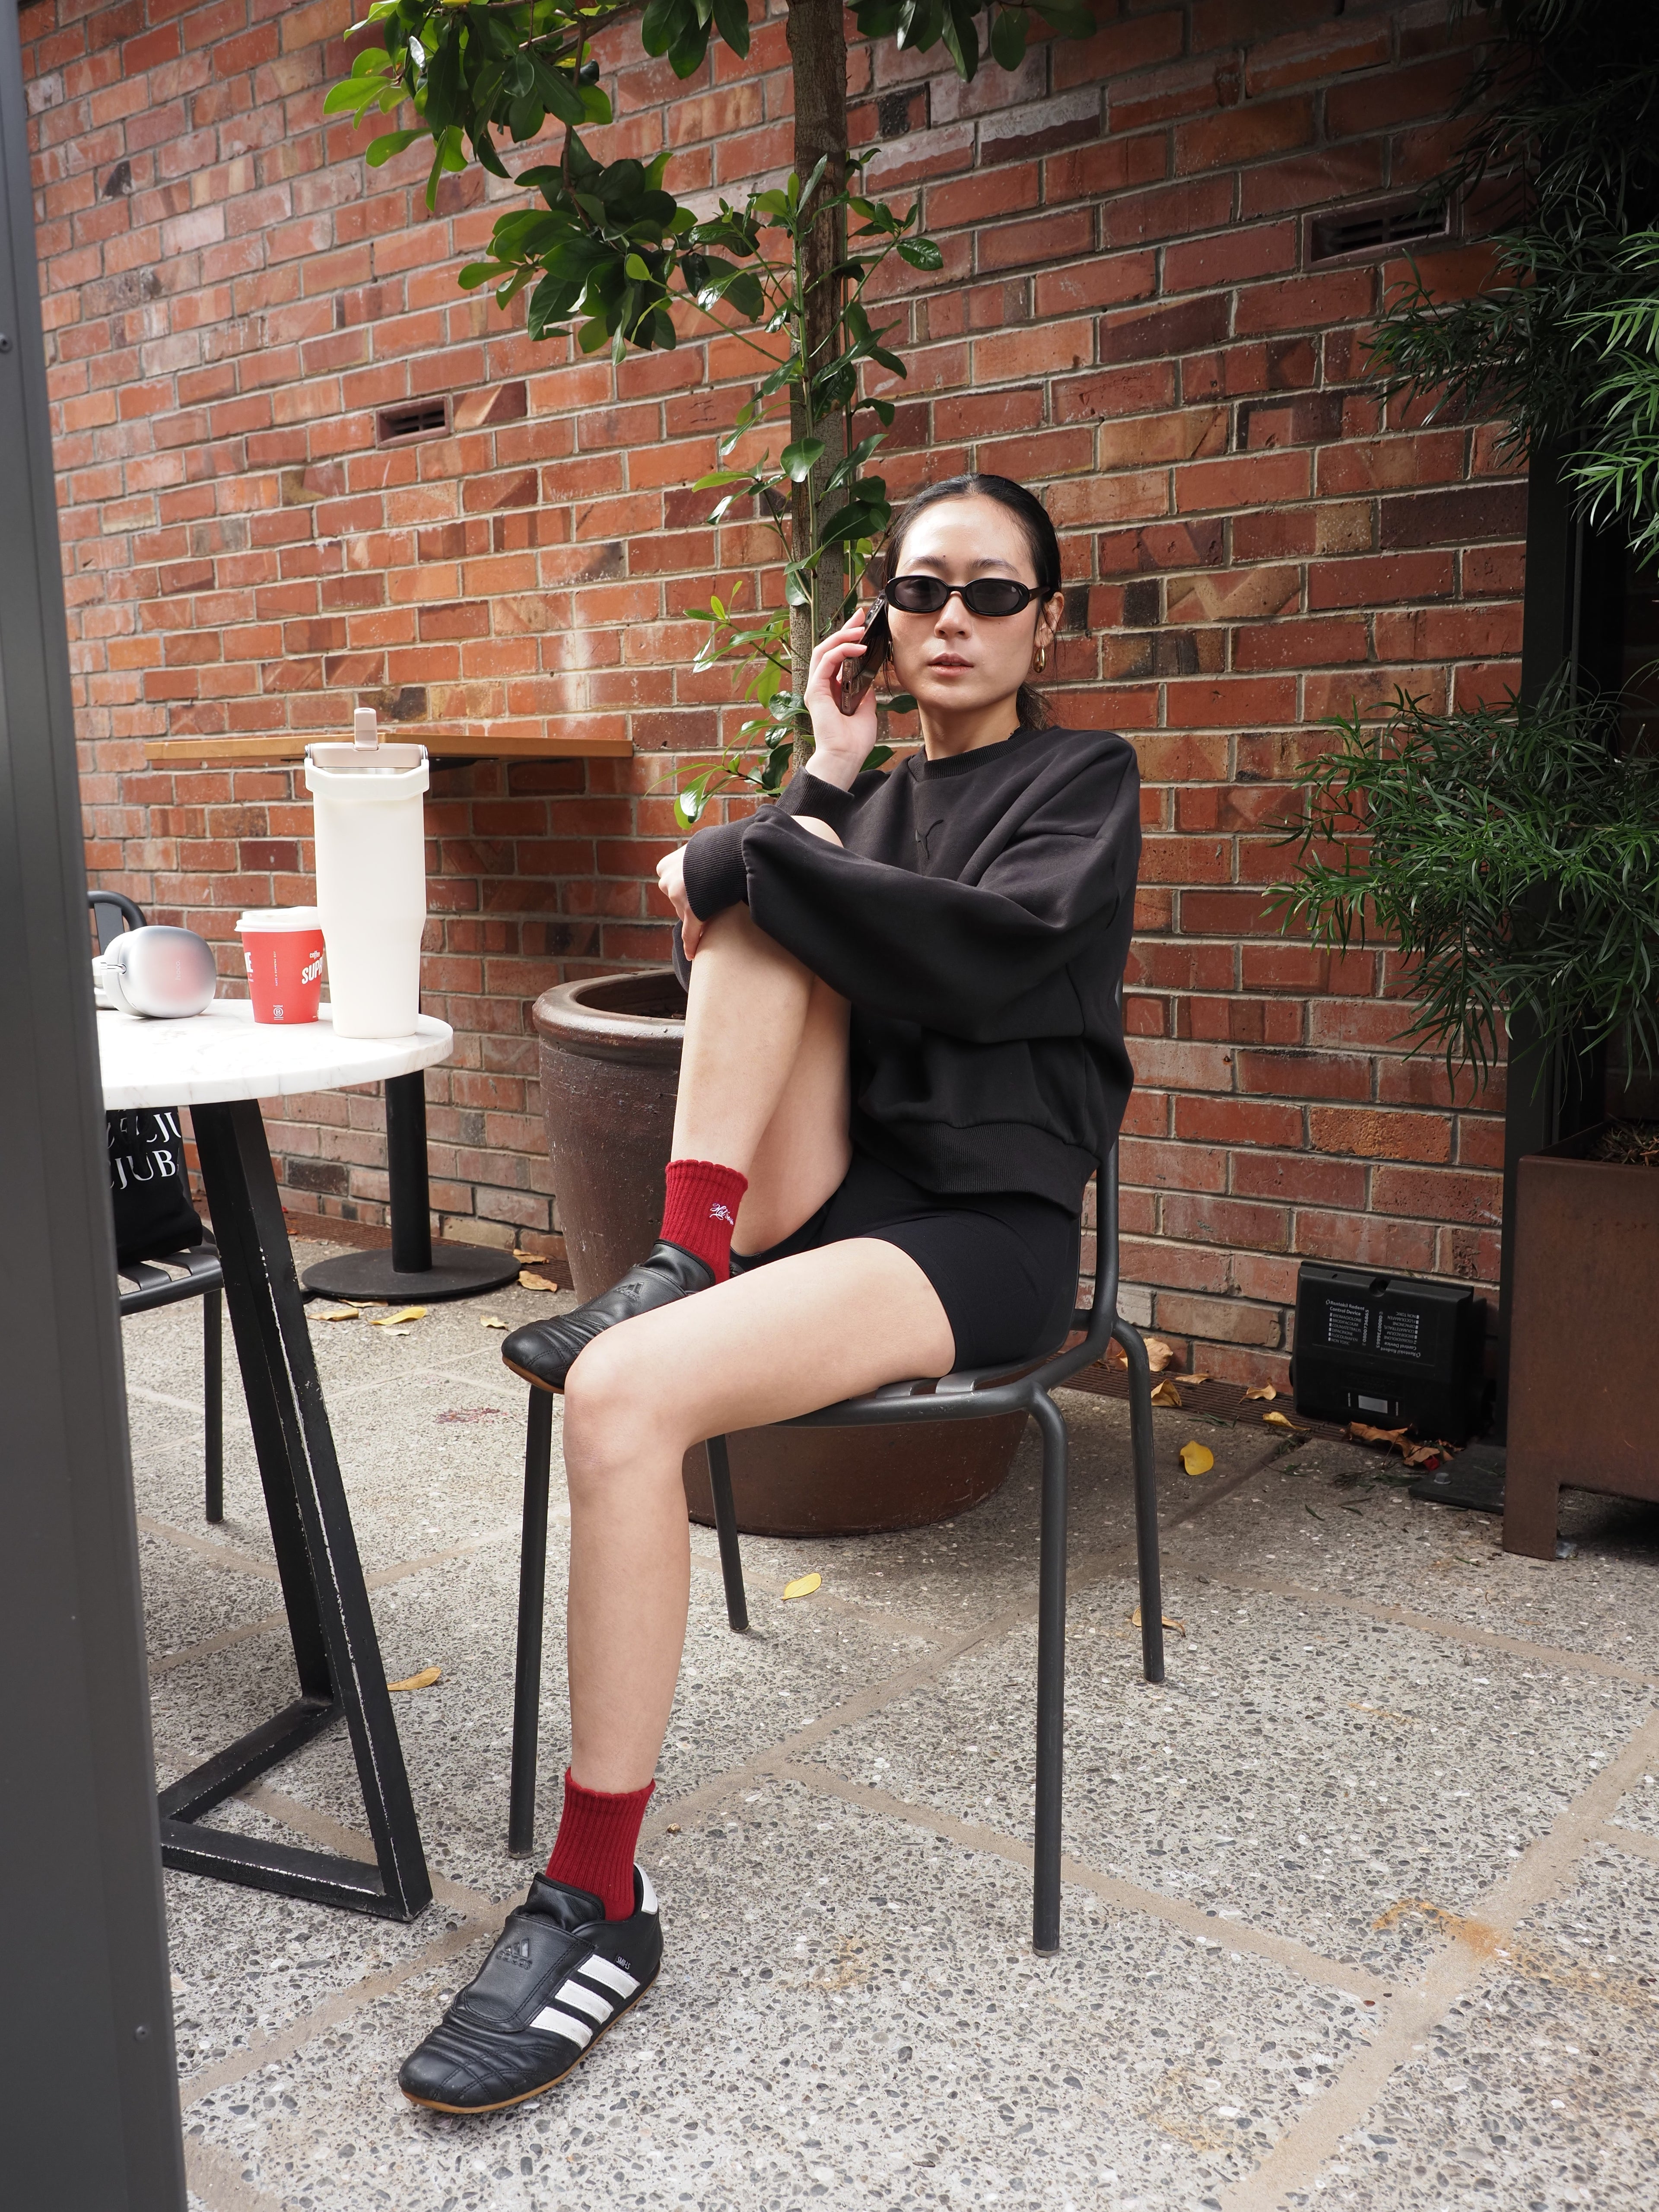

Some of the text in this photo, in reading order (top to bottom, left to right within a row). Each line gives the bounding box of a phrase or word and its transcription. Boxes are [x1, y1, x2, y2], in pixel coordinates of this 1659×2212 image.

[309, 950, 321, 960] coffee
[614, 1289, 641, 1301] adidas
[497, 1951, 532, 1970] adidas
